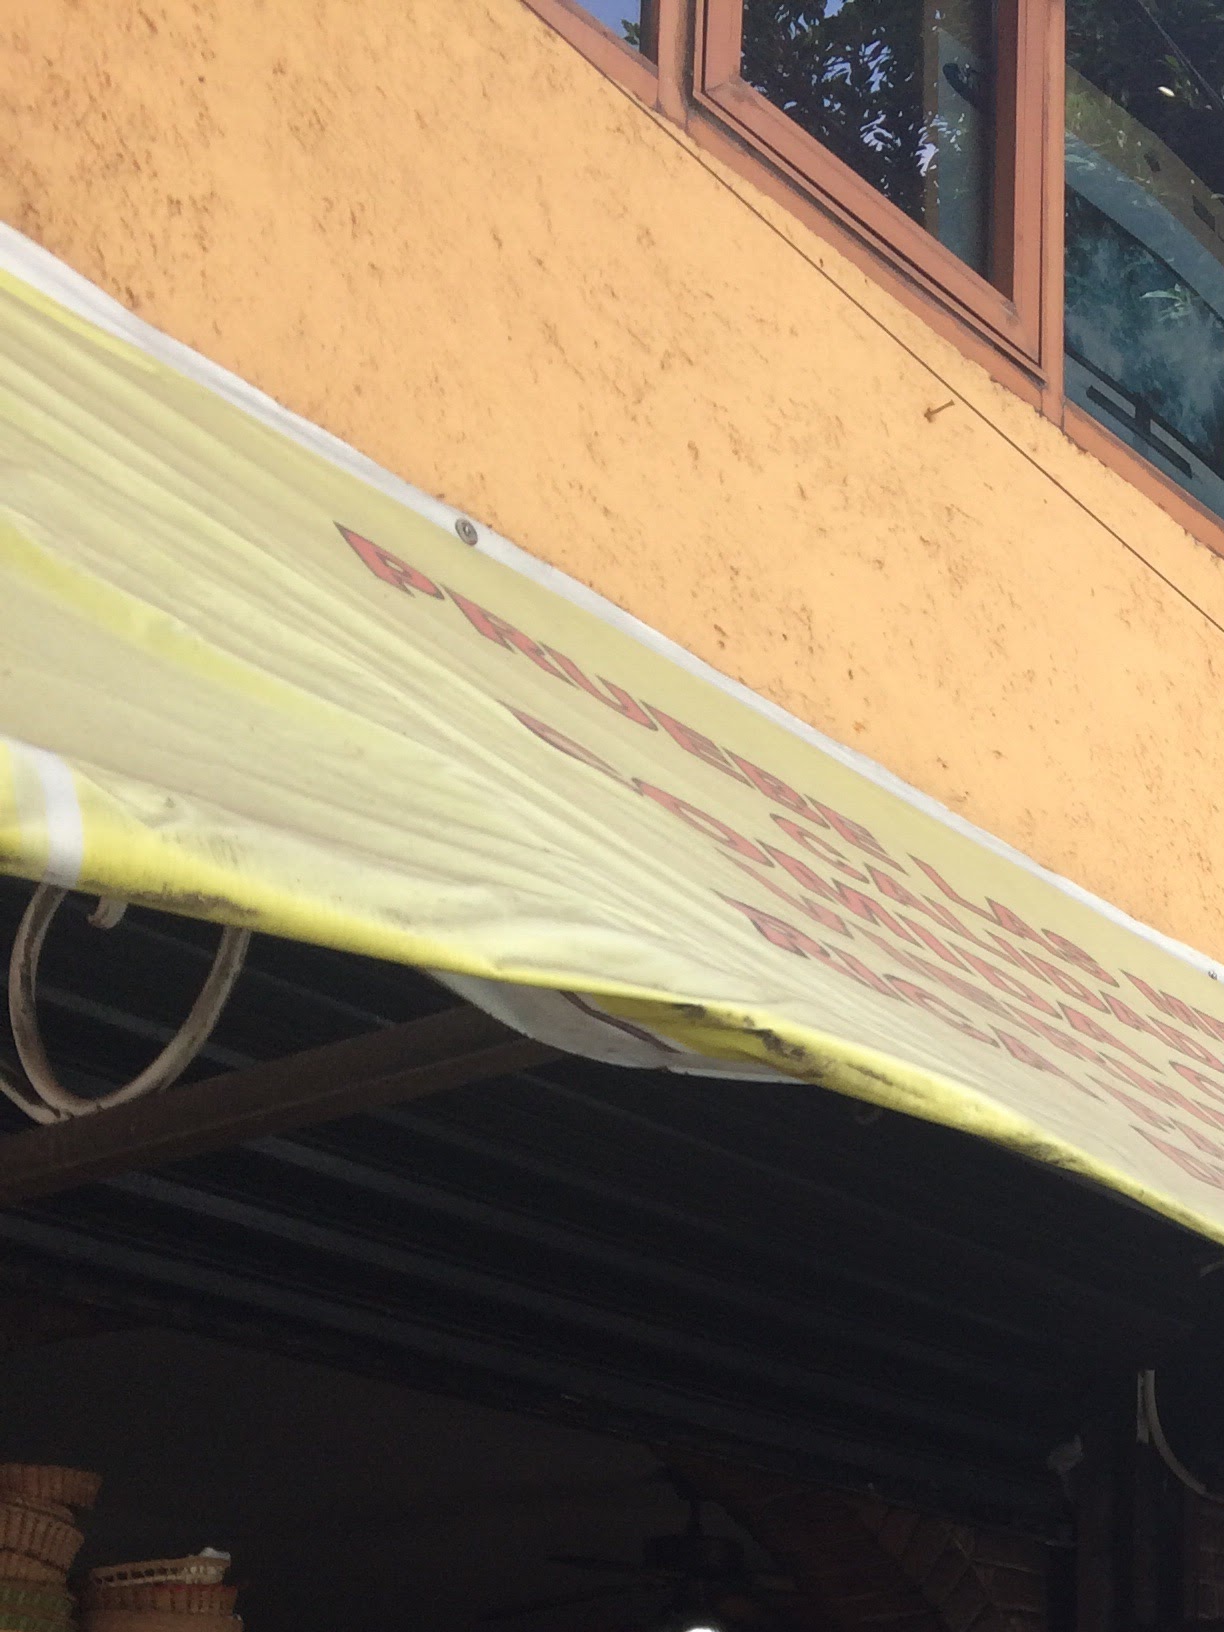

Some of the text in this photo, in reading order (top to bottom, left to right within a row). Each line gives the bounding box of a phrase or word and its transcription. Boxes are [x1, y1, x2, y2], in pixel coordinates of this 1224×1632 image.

[333, 521, 907, 876] PRUEBE
[907, 853, 1120, 989] LAS
[497, 699, 1159, 1071] COMIDA
[715, 888, 1105, 1101] RICA
